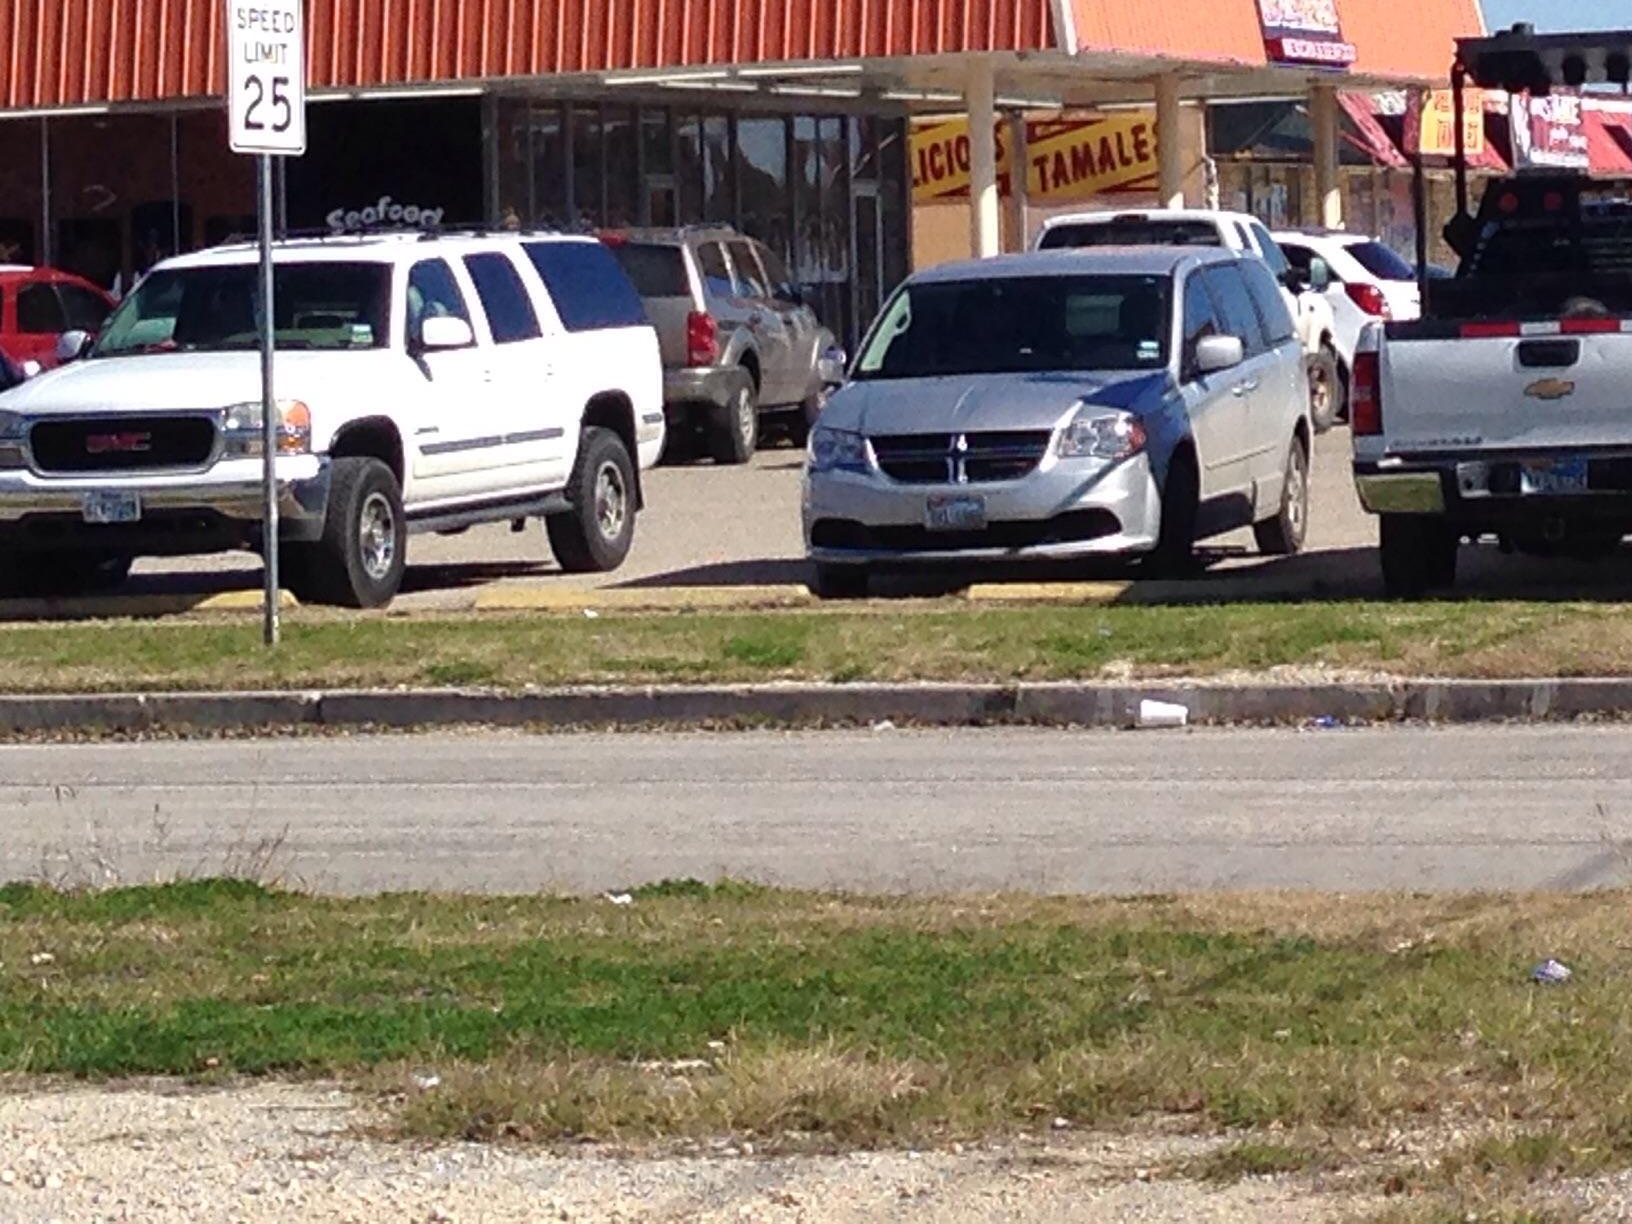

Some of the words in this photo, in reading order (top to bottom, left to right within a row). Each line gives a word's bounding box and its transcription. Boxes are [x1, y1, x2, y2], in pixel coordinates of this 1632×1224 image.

[237, 7, 295, 34] SPEED
[244, 41, 288, 64] LIMIT
[244, 74, 292, 133] 25
[326, 196, 444, 229] Seafood
